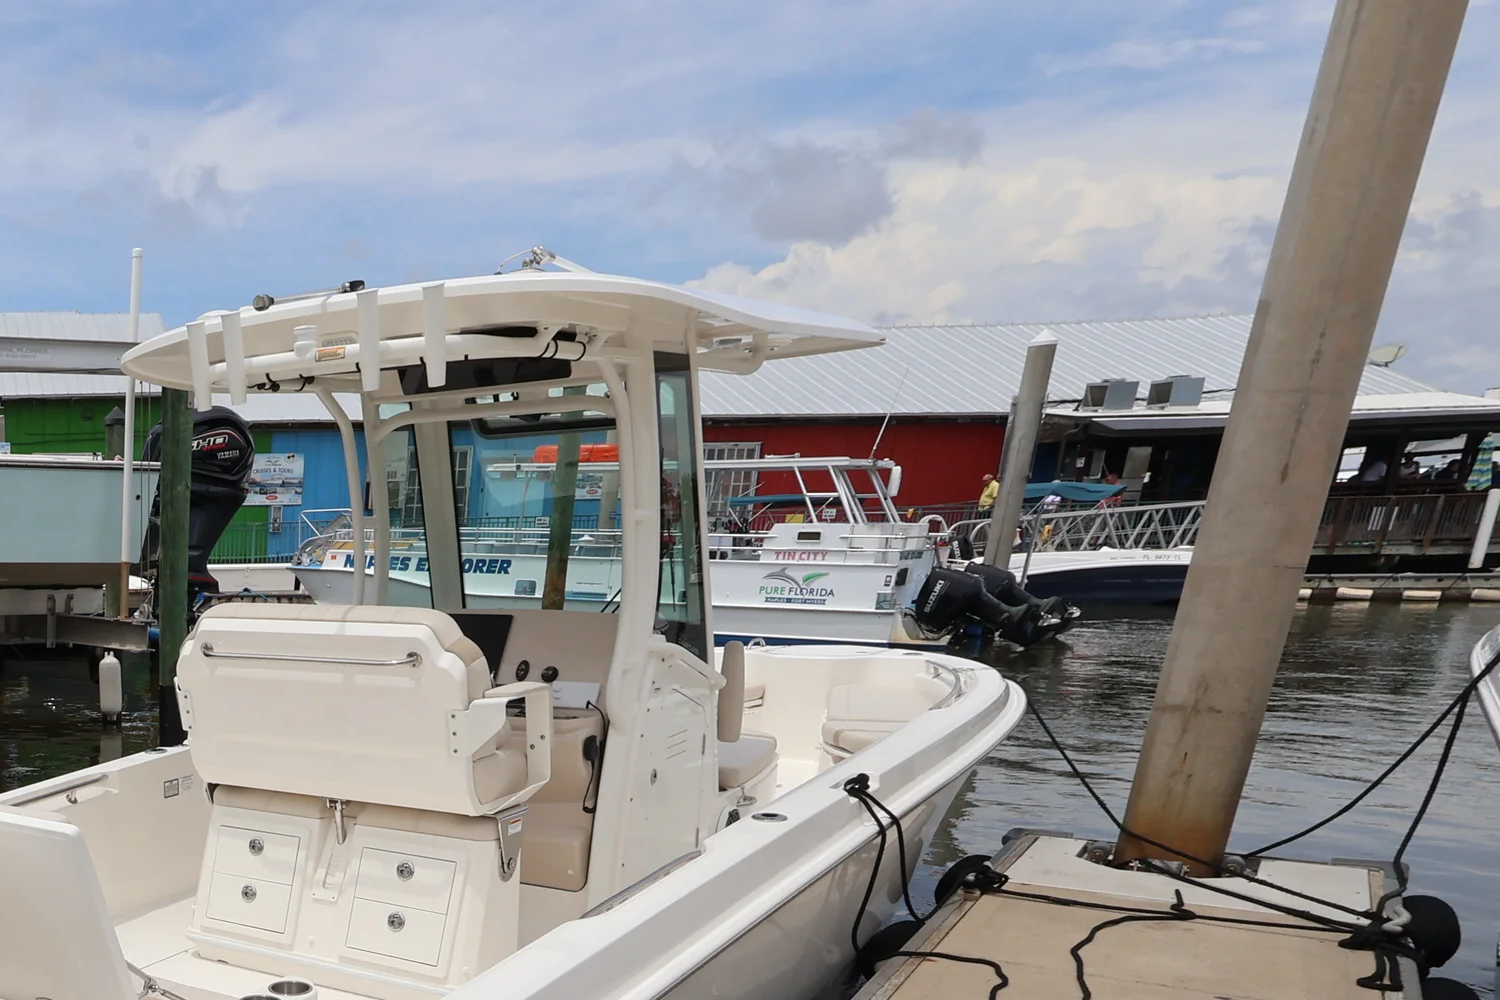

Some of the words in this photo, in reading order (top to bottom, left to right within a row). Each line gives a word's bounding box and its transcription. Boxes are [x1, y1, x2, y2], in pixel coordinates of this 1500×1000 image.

[216, 450, 240, 460] YAMAHA
[278, 467, 294, 475] TOURS
[774, 551, 796, 561] TIN
[798, 551, 828, 561] CITY
[758, 585, 786, 596] PURE
[788, 586, 835, 598] FLORIDA
[924, 580, 945, 613] SUZUKI
